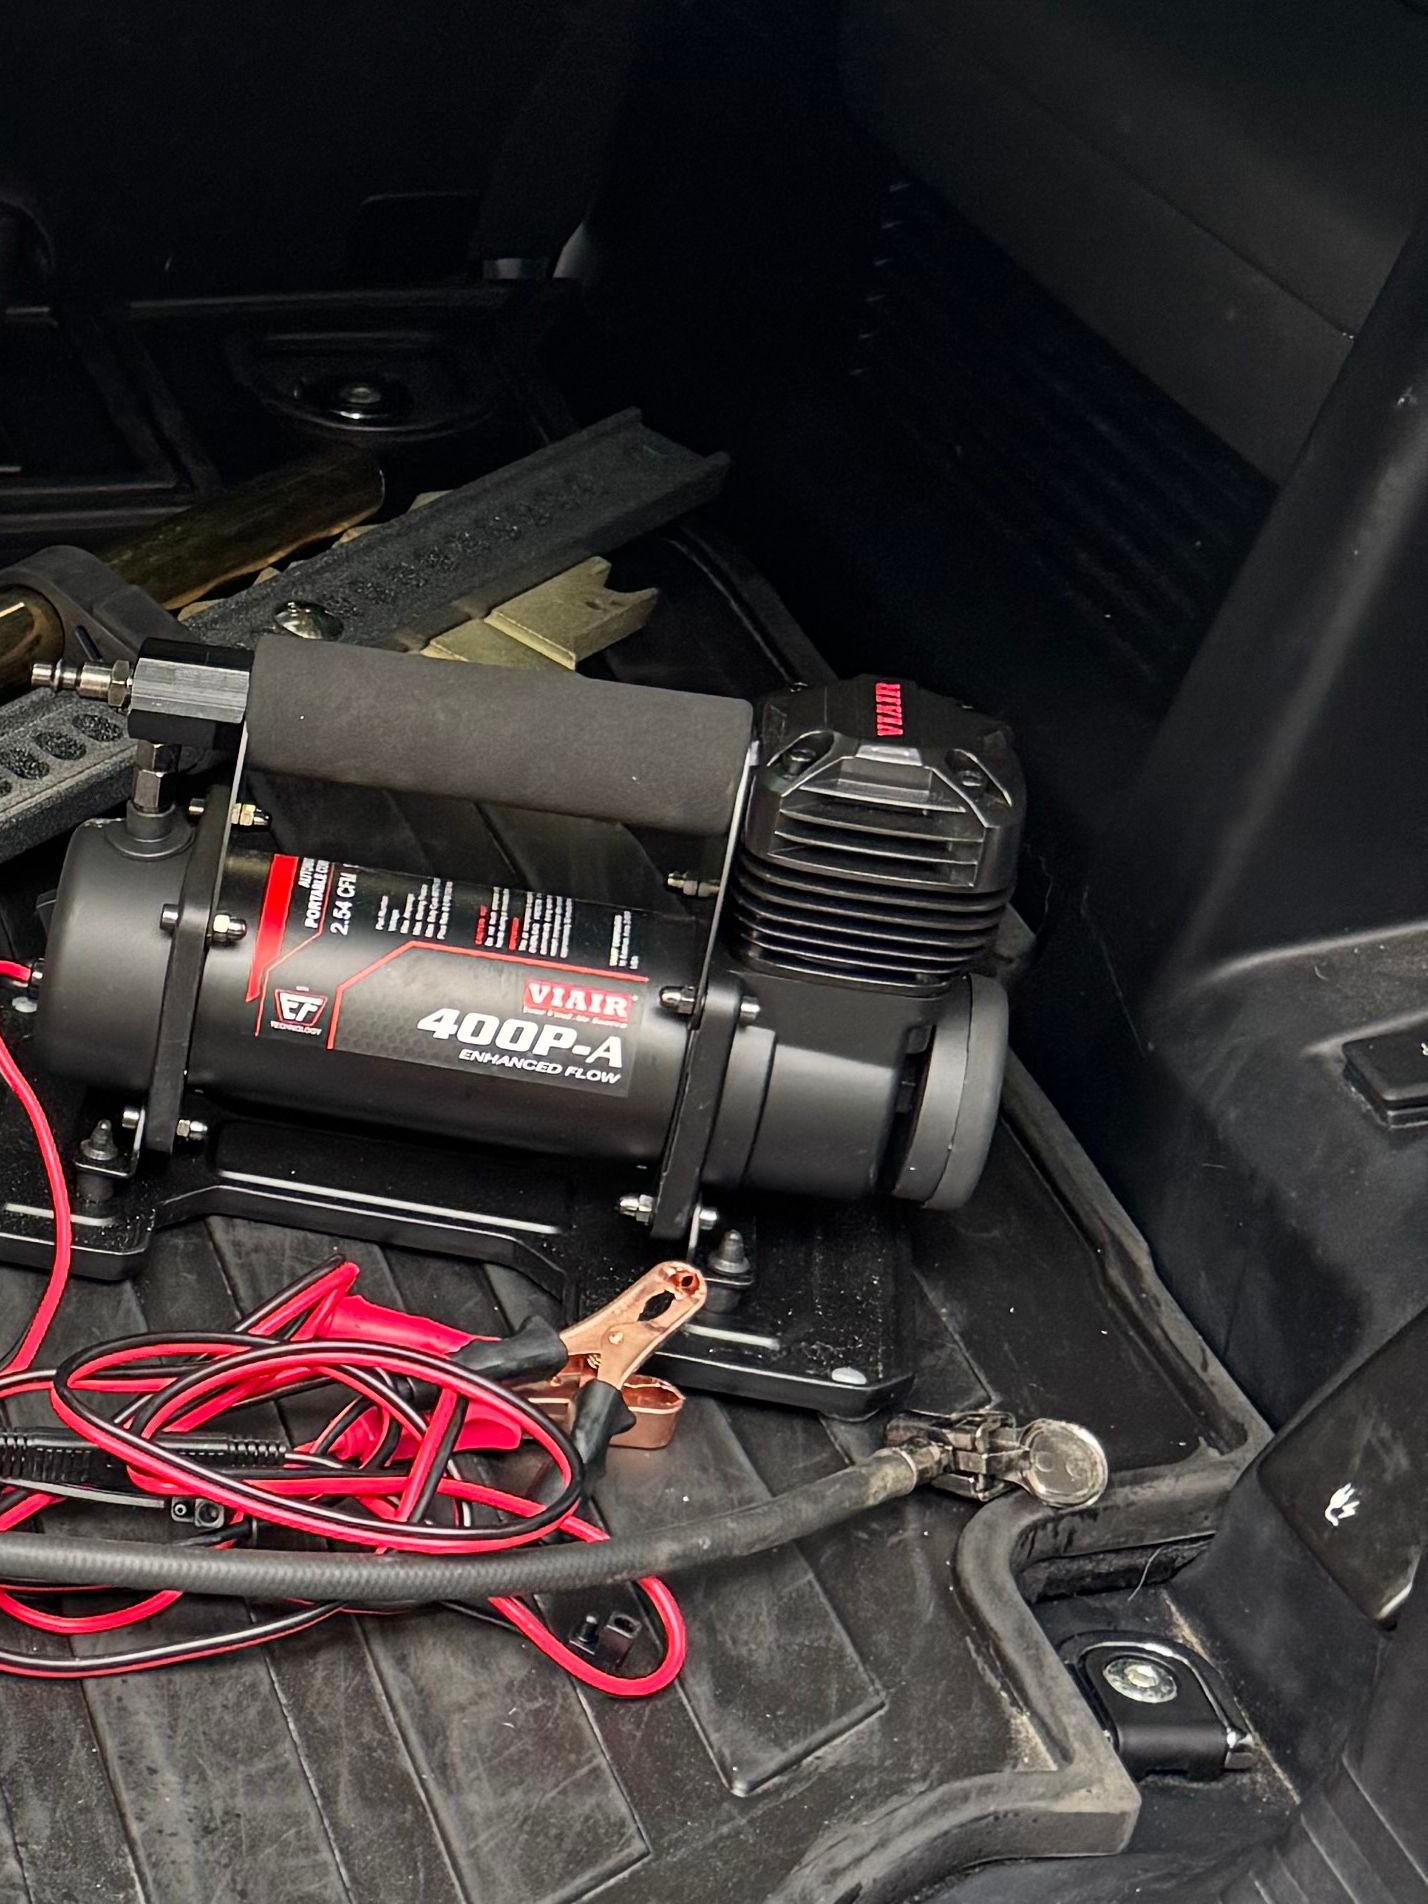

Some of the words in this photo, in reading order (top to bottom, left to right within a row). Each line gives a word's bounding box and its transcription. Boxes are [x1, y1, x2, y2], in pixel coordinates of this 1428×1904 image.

[876, 682, 903, 736] VIAIR
[304, 873, 328, 928] PORTABLE
[336, 873, 357, 897] CFM
[330, 900, 353, 935] 2.54
[529, 984, 628, 1017] VIAIR
[270, 1021, 322, 1036] TECHNOLOGY
[417, 1008, 623, 1068] 400P-A
[459, 1049, 562, 1075] ENHANCED
[565, 1066, 621, 1085] FLOW
